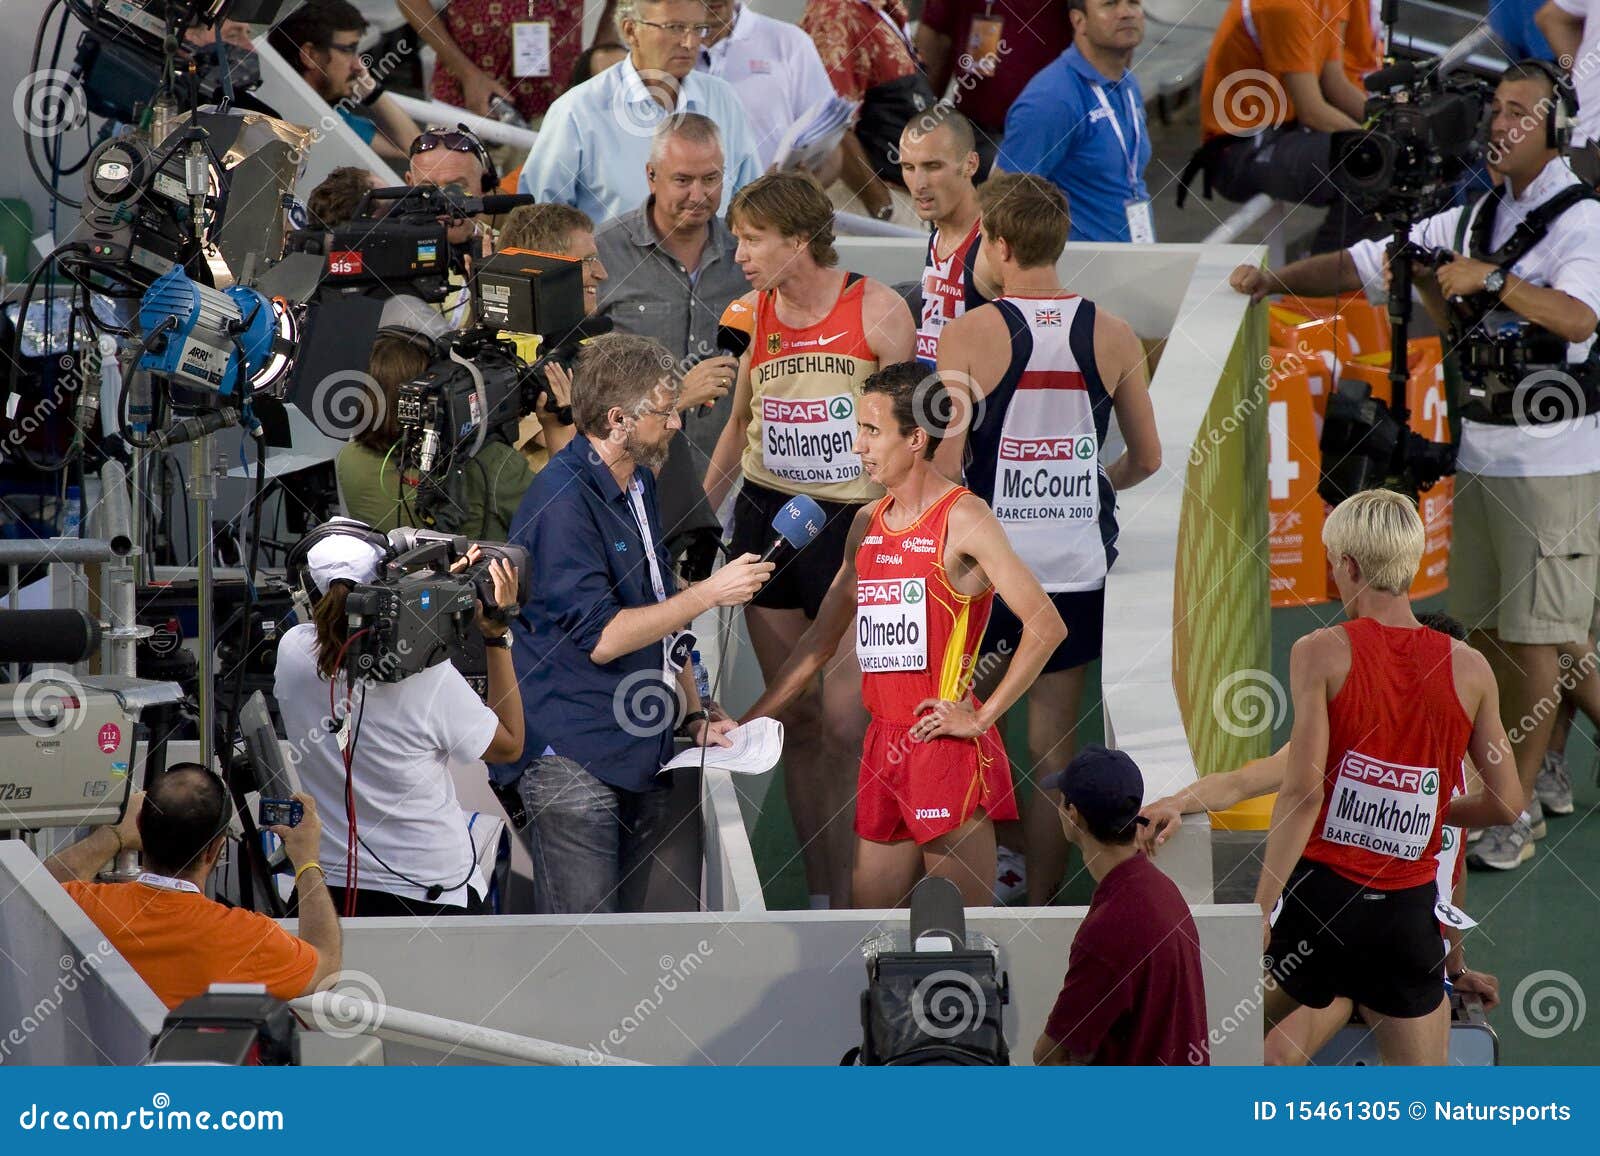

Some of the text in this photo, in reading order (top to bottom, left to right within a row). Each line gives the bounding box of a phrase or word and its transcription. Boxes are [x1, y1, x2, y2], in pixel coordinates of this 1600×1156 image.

[331, 260, 352, 272] sis
[188, 346, 209, 361] ARRI
[764, 401, 827, 421] SPAR
[768, 425, 853, 463] Schlangen
[1002, 440, 1072, 459] SPAR
[836, 465, 861, 479] 2010
[1003, 468, 1092, 498] McCourt
[785, 502, 801, 520] tve
[996, 506, 1094, 519] BARCELONA 2010
[910, 544, 937, 554] Pastora
[912, 537, 934, 546] Divina
[875, 554, 903, 565] ESPAÑA
[858, 583, 901, 603] SPAR
[859, 613, 919, 648] Olmedo
[902, 654, 924, 668] 2010
[103, 731, 116, 740] T12
[36, 740, 60, 748] Canon
[1344, 758, 1420, 791] SPAR
[1336, 787, 1431, 836] Munkholm
[1326, 827, 1400, 855] BARCELONA
